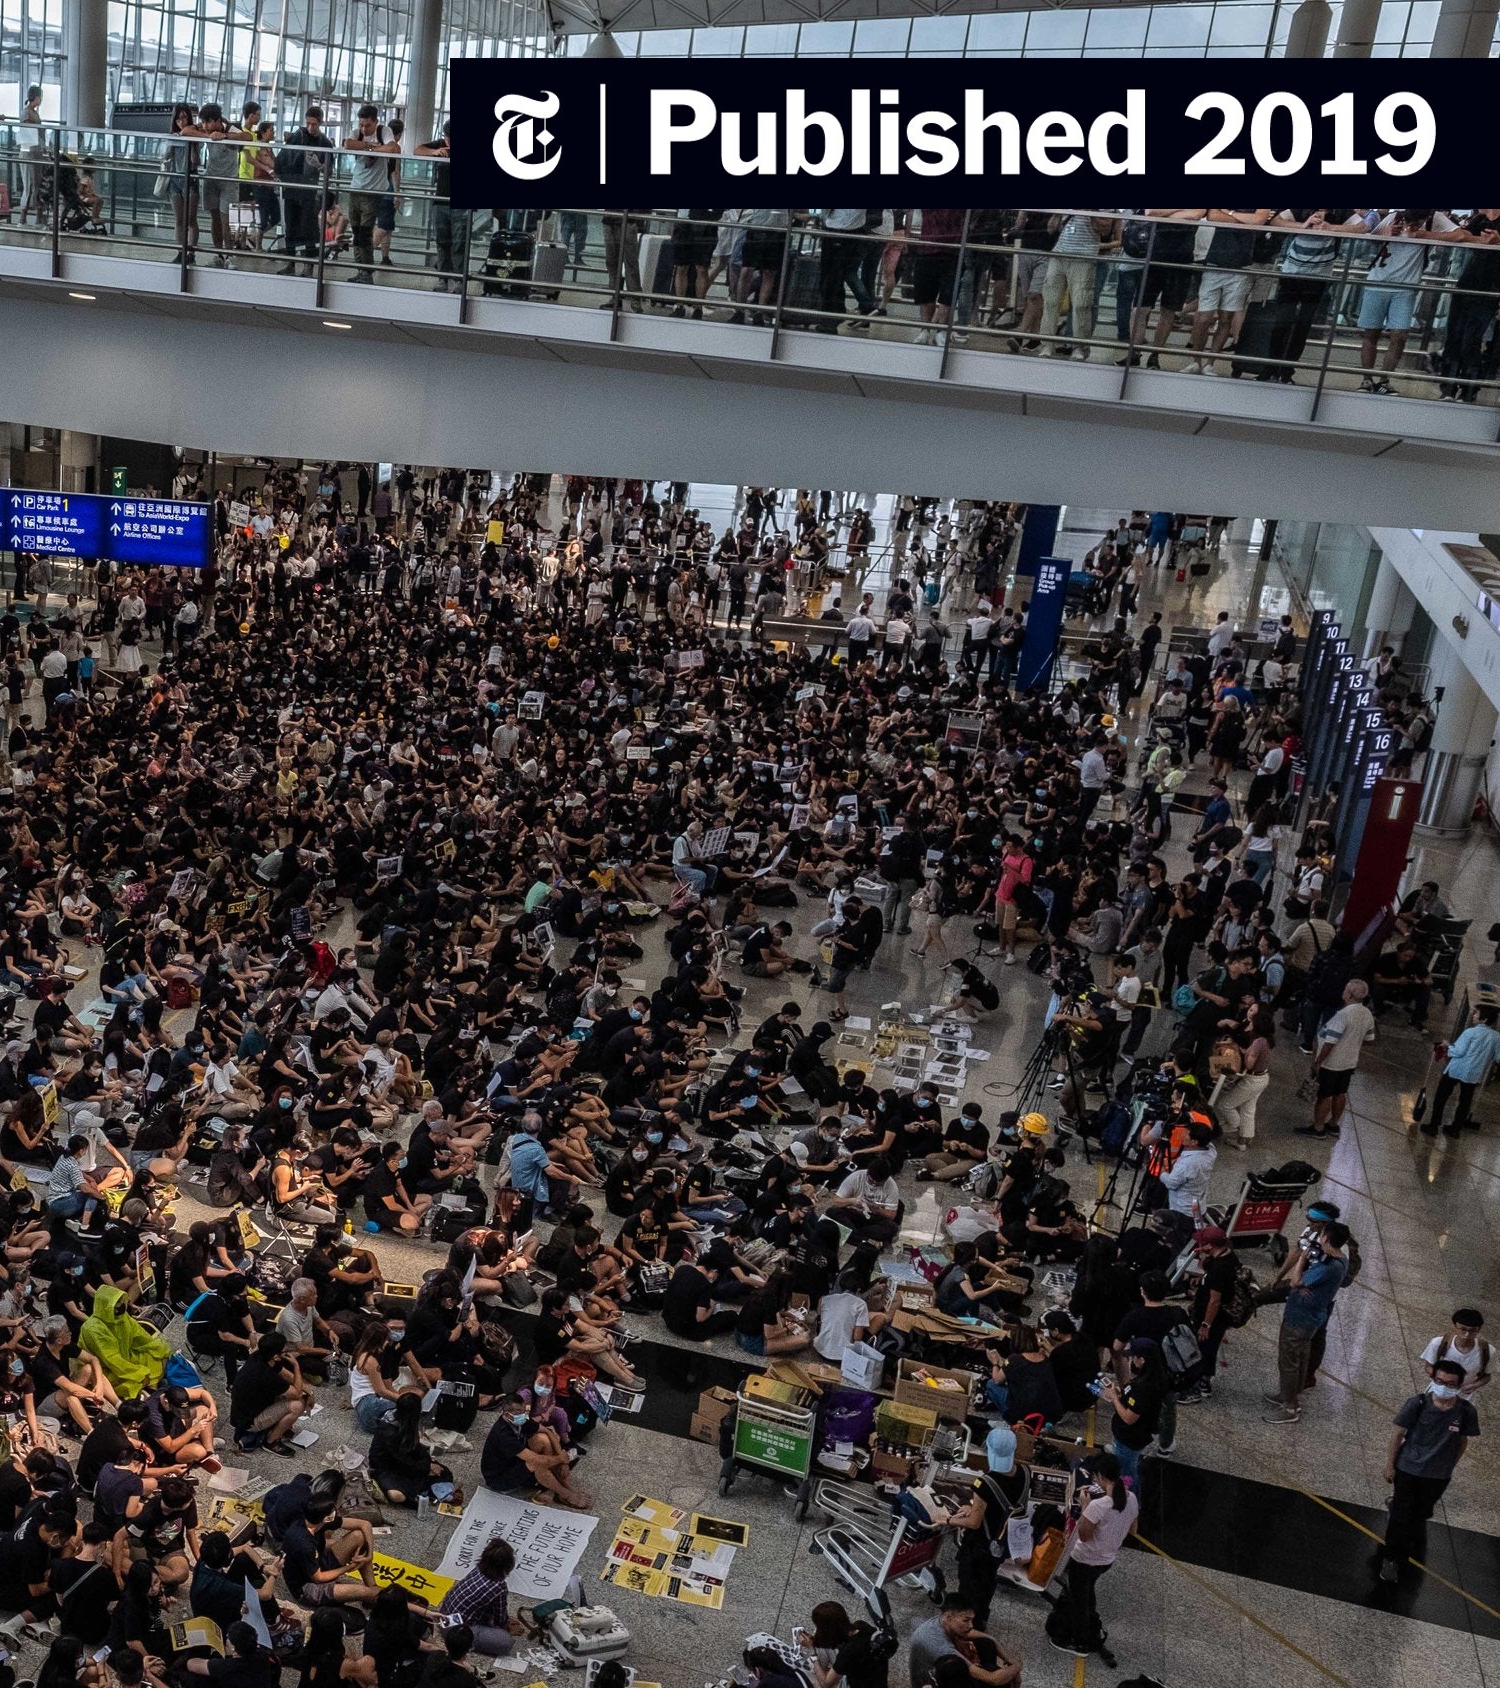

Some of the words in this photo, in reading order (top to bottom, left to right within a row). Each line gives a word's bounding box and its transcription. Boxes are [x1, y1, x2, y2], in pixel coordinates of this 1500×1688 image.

[62, 498, 69, 512] 1
[145, 513, 190, 522] AsiaWorld-Expo
[36, 524, 64, 532] Limousine
[64, 526, 85, 534] Lounge
[123, 522, 184, 535] 航空公司辦公室
[142, 532, 161, 540] Offices
[1322, 613, 1331, 624] 9
[1326, 626, 1339, 639] 10
[1334, 641, 1347, 654] 11
[1339, 656, 1353, 670] 12
[1349, 674, 1364, 688] 13
[1356, 692, 1370, 707] 14
[1365, 712, 1381, 727] 15
[1375, 734, 1390, 750] 16
[469, 1519, 487, 1531] THE
[506, 1509, 540, 1545] FIGHTING
[463, 1534, 479, 1546] FOR
[553, 1526, 583, 1553] HOME
[515, 1554, 540, 1572] THE
[529, 1522, 562, 1554] FUTURE
[455, 1545, 473, 1569] SORRY
[542, 1554, 566, 1573] OUR
[533, 1574, 553, 1587] OF
